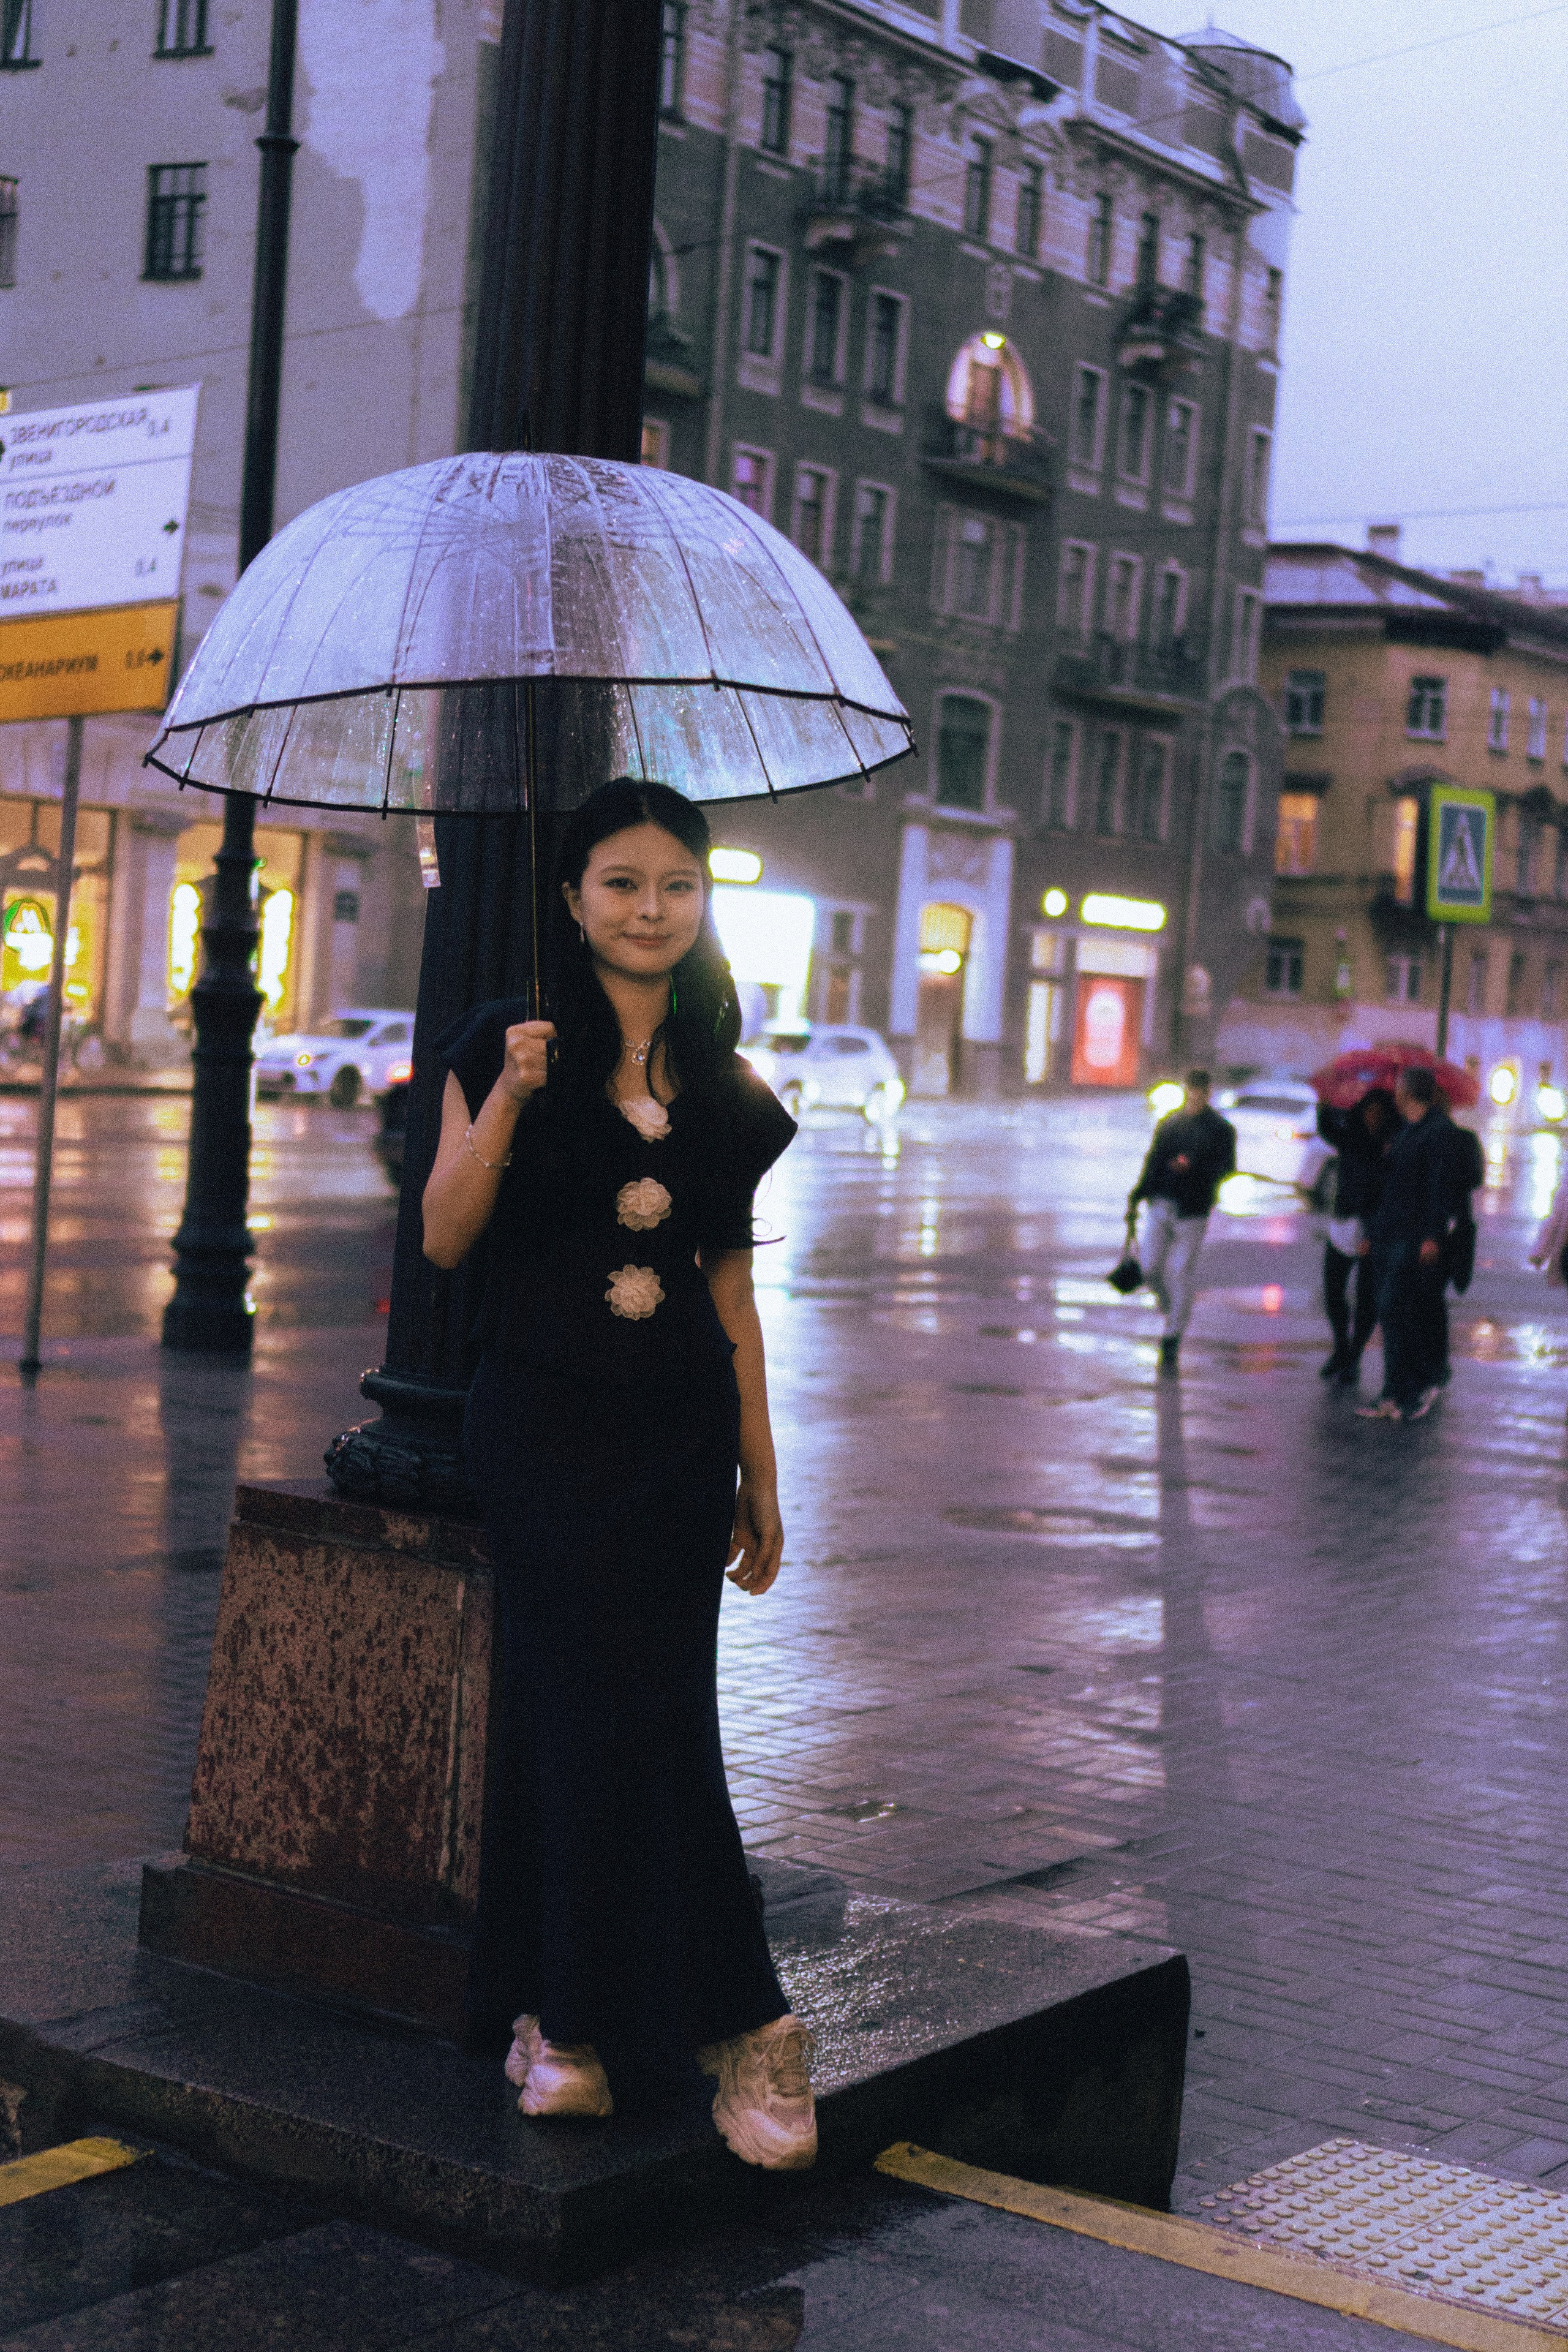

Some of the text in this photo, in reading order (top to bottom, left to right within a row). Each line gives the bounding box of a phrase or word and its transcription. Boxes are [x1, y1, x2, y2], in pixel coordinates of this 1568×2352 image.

[10, 407, 148, 445] ЗВЕНИГОРОДСКАЯ
[9, 450, 53, 472] улица
[4, 478, 116, 510] ПОДЪЕЗДНОЙ
[2, 512, 72, 534] переулок
[1, 556, 45, 578] улица
[0, 578, 58, 600] МАРАТА
